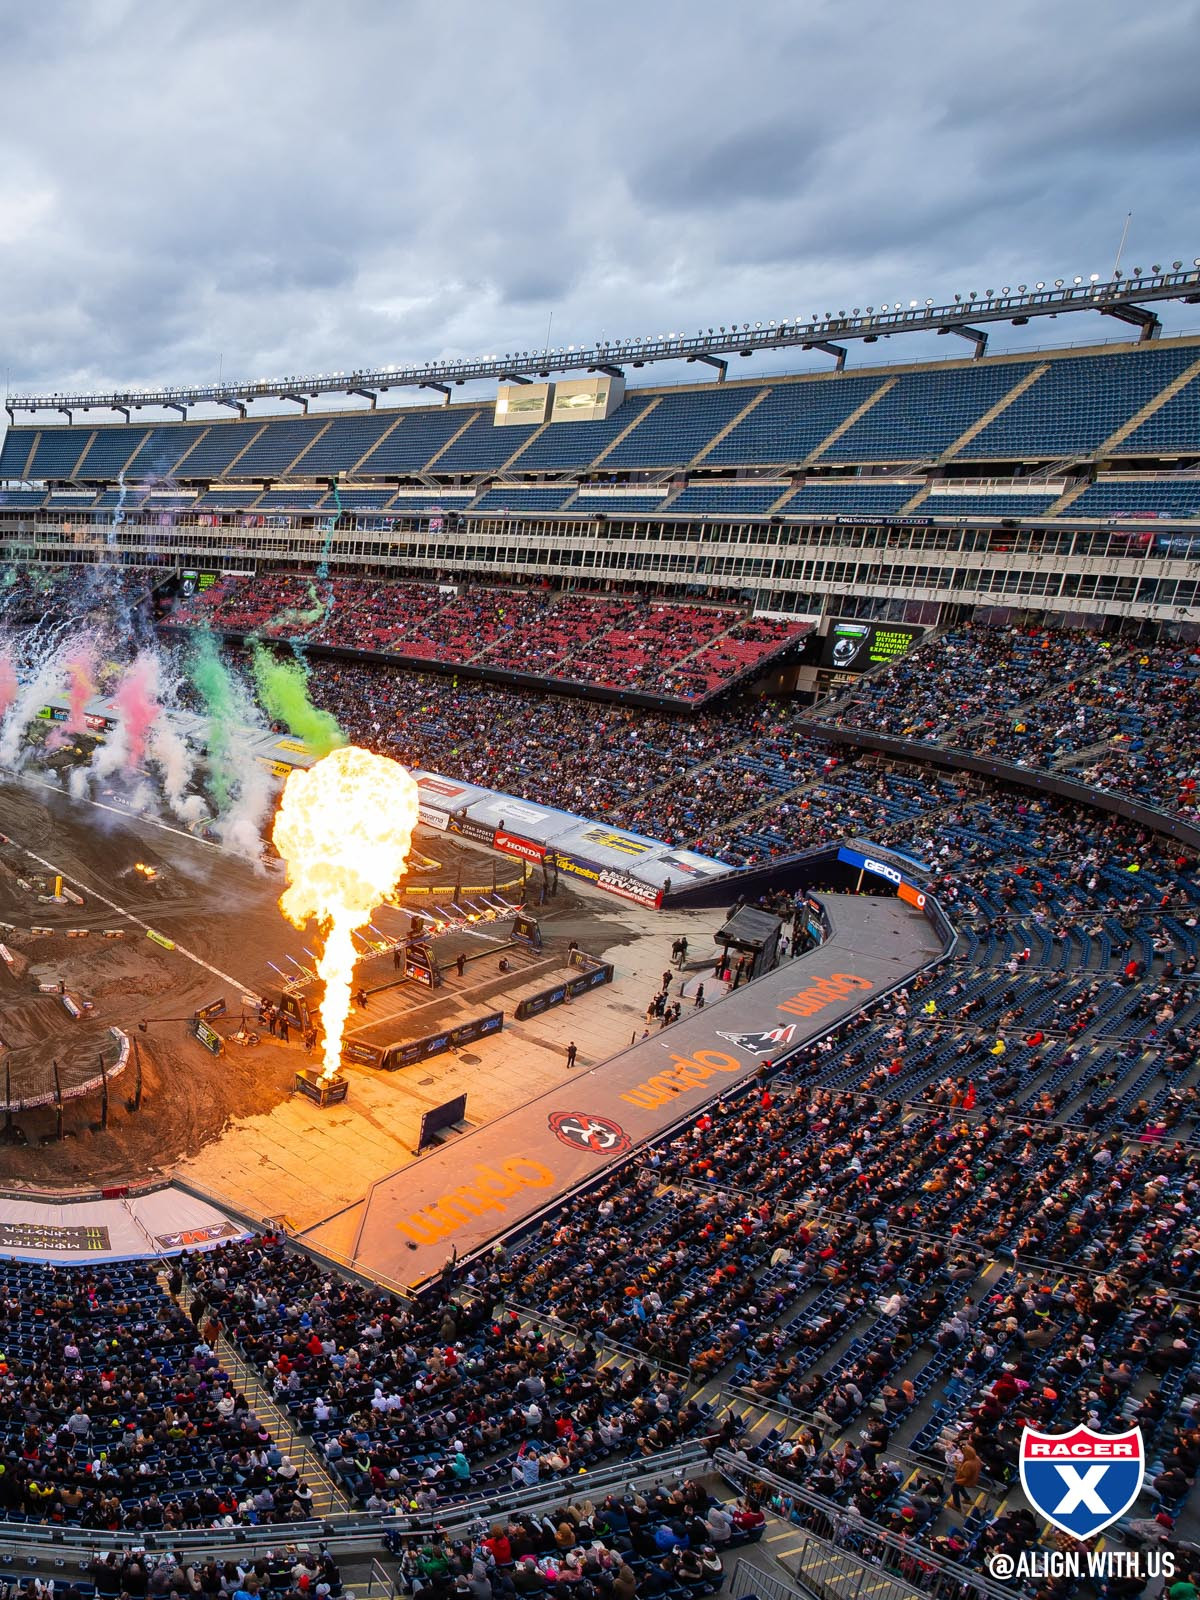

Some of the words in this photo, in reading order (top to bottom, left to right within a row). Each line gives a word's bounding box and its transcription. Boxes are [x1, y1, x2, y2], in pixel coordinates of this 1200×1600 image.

[875, 631, 912, 640] GILLETTE'S
[876, 636, 910, 645] ULTIMATE
[462, 823, 475, 831] UTAH
[476, 828, 494, 838] SPORTS
[462, 829, 494, 843] COMMISSION
[506, 842, 542, 859] HONDA
[556, 859, 599, 881] alpinestars
[863, 858, 902, 883] GEICO
[161, 1224, 225, 1246] AMA
[2, 1238, 81, 1249] MONSTER
